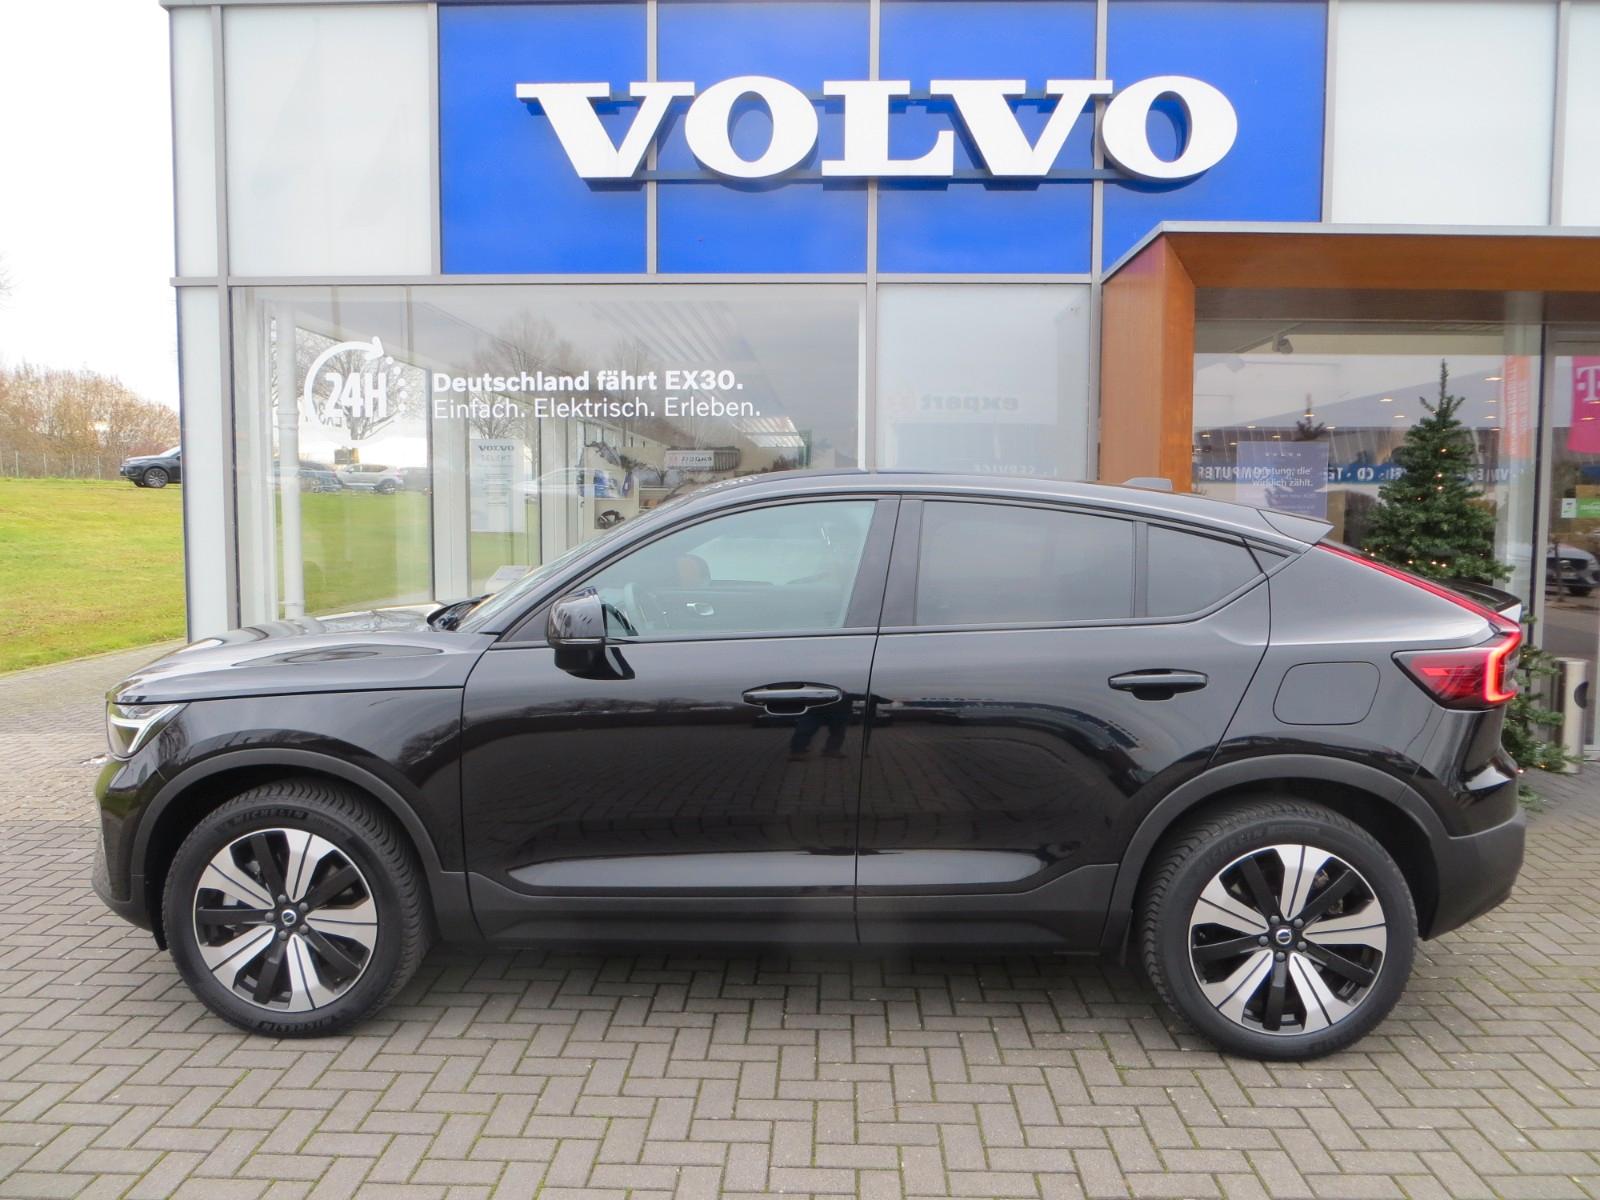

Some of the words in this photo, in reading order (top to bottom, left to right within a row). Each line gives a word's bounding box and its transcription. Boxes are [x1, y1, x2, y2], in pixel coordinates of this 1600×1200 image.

[516, 75, 1238, 179] VOLVO
[433, 371, 590, 392] Deutschland
[596, 369, 657, 391] fährt
[665, 369, 744, 390] EX30.
[325, 372, 387, 418] 24H
[433, 397, 526, 419] Einfach.
[534, 396, 656, 418] Elektrisch.
[664, 396, 761, 417] Erleben.
[478, 444, 515, 452] VOLVO
